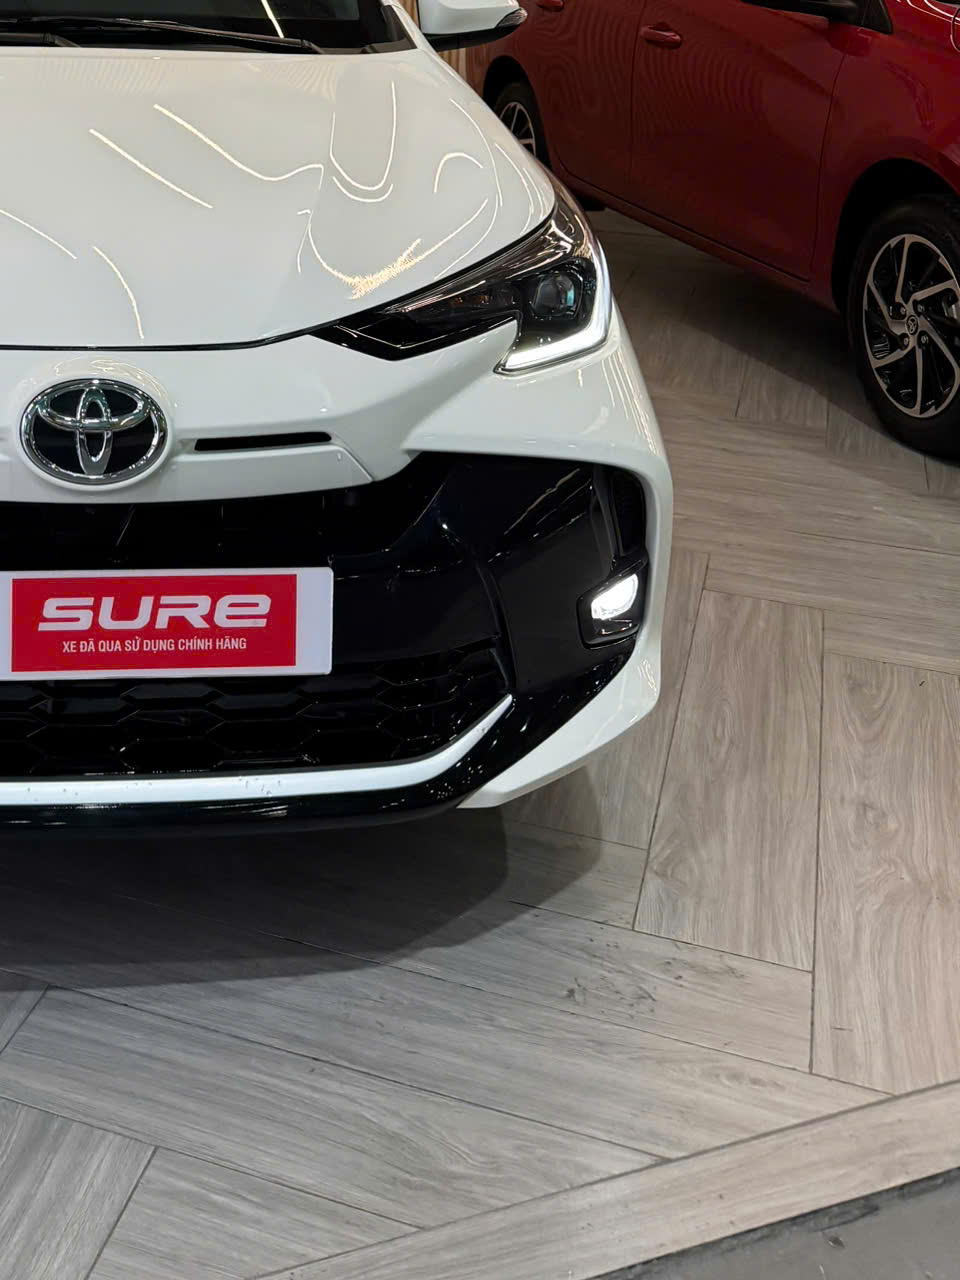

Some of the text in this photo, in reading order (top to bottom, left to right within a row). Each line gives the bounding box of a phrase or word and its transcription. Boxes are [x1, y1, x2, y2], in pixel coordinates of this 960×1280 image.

[62, 640, 77, 653] XE
[79, 638, 95, 652] ĐÃ
[98, 639, 122, 652] QUA
[124, 635, 141, 652] SỬ
[143, 639, 175, 654] DỤNG
[178, 635, 212, 651] CHÍNH
